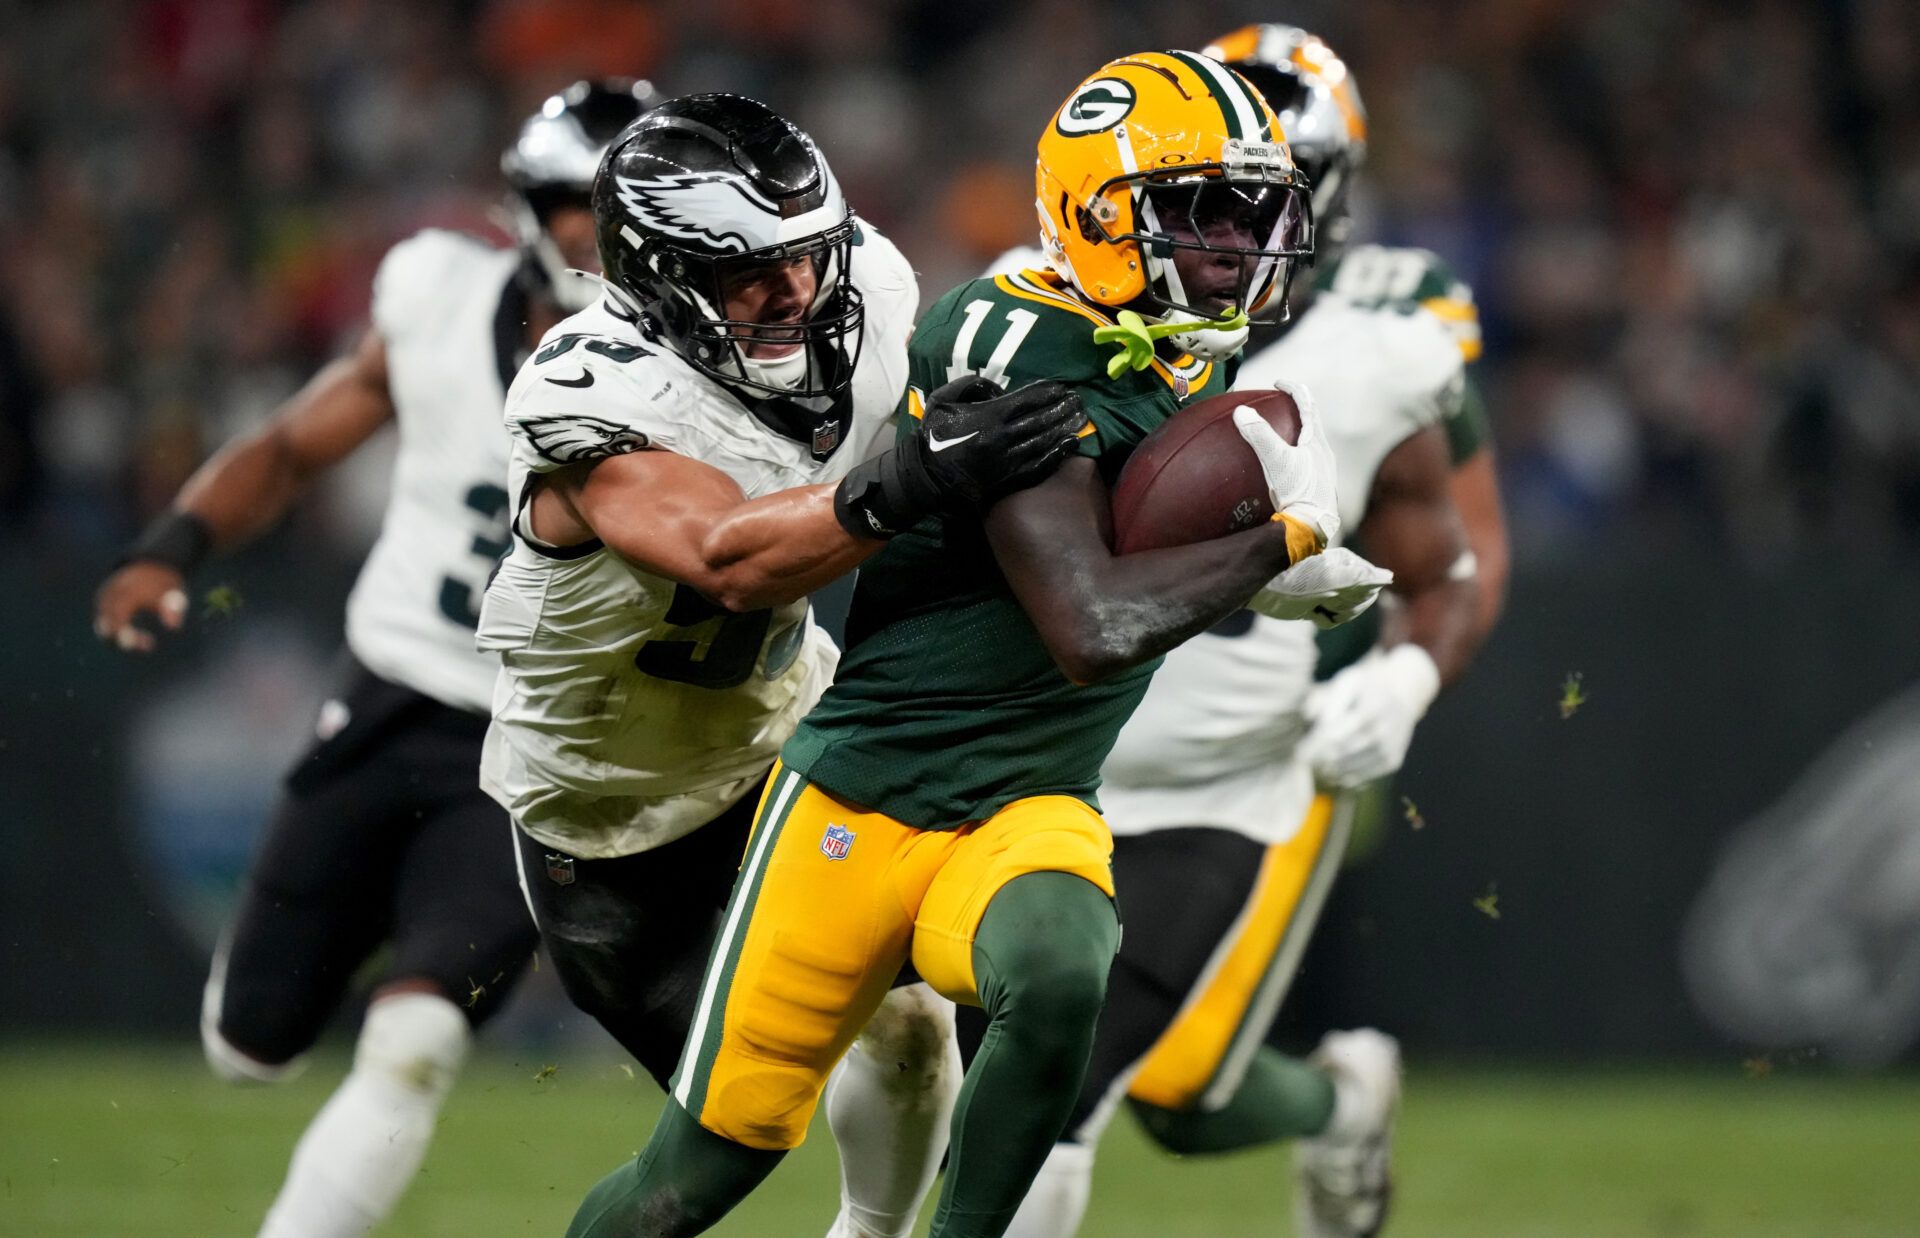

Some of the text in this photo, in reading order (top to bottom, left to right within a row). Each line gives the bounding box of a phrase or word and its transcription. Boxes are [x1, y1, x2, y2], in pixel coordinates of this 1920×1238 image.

[1243, 147, 1268, 157] PACKERS
[945, 299, 1039, 390] 11
[824, 837, 847, 856] NFL
